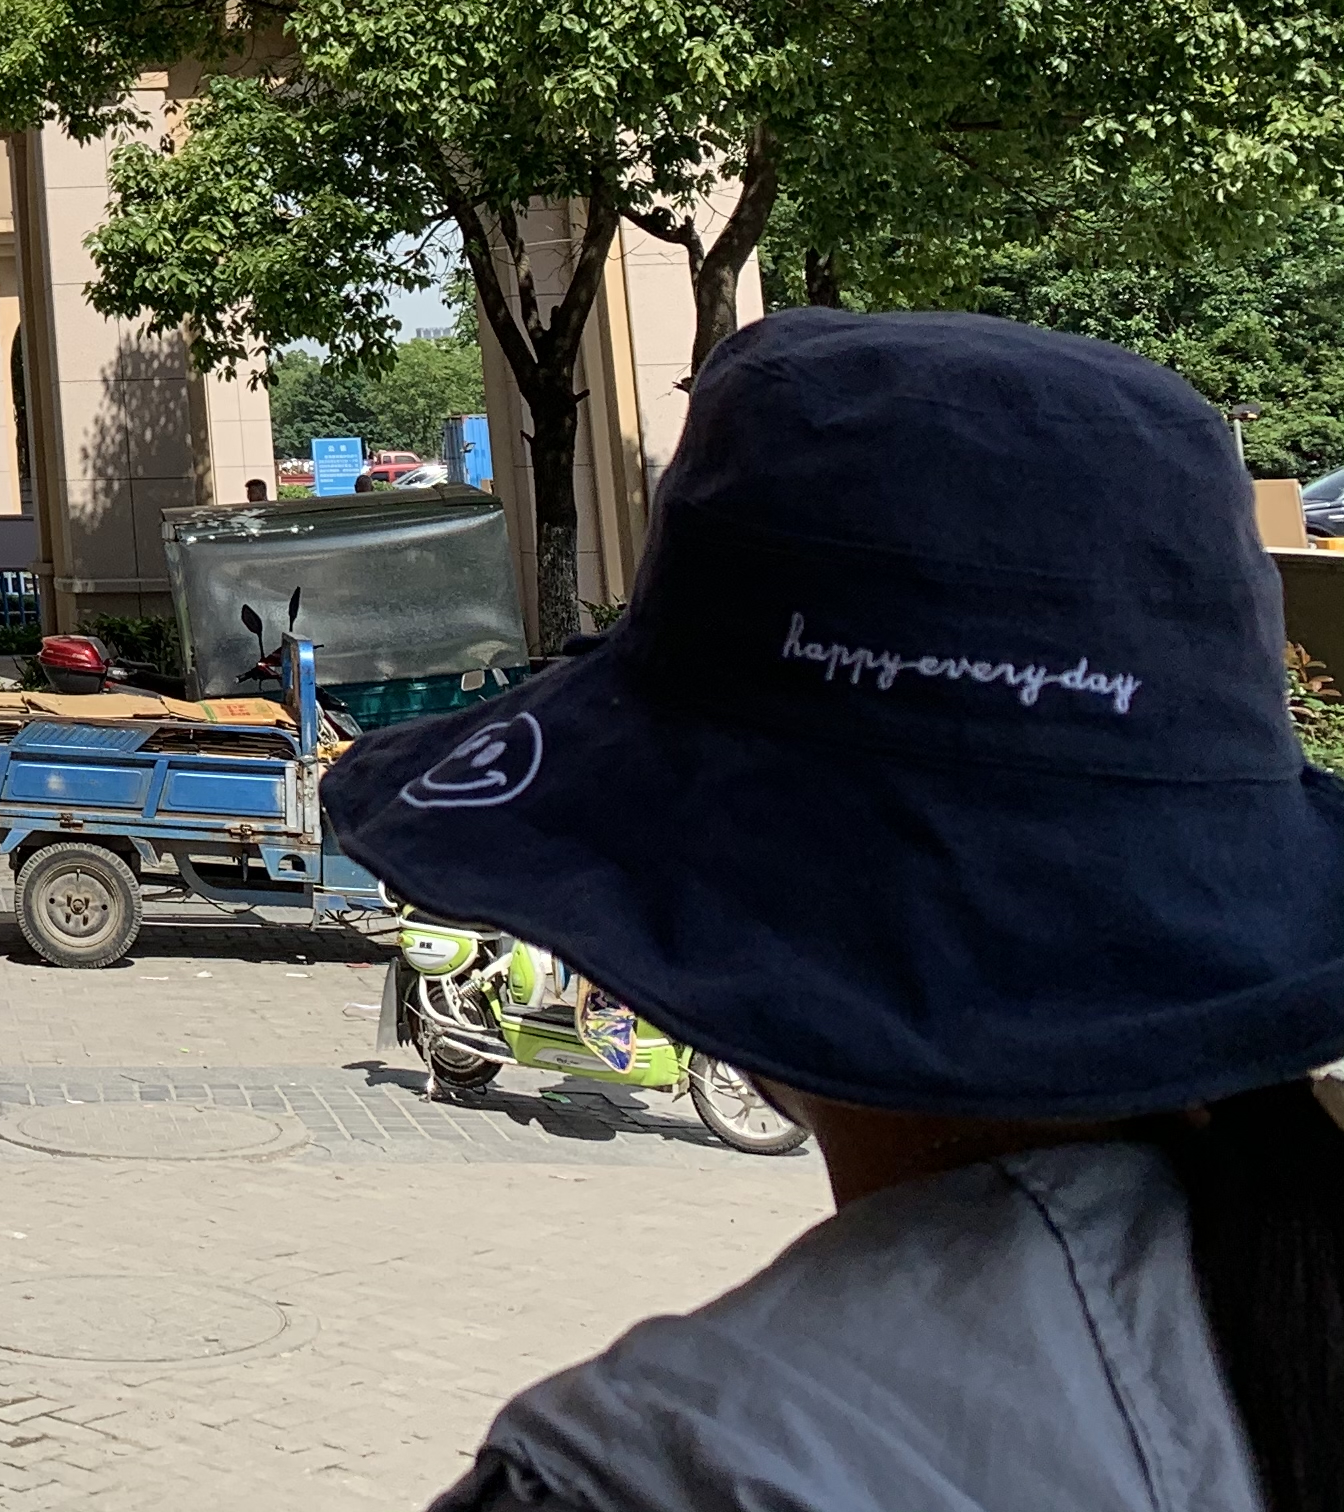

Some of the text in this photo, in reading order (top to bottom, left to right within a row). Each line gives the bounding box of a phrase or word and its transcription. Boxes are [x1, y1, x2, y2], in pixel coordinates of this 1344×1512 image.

[782, 611, 1143, 714] happy every day
